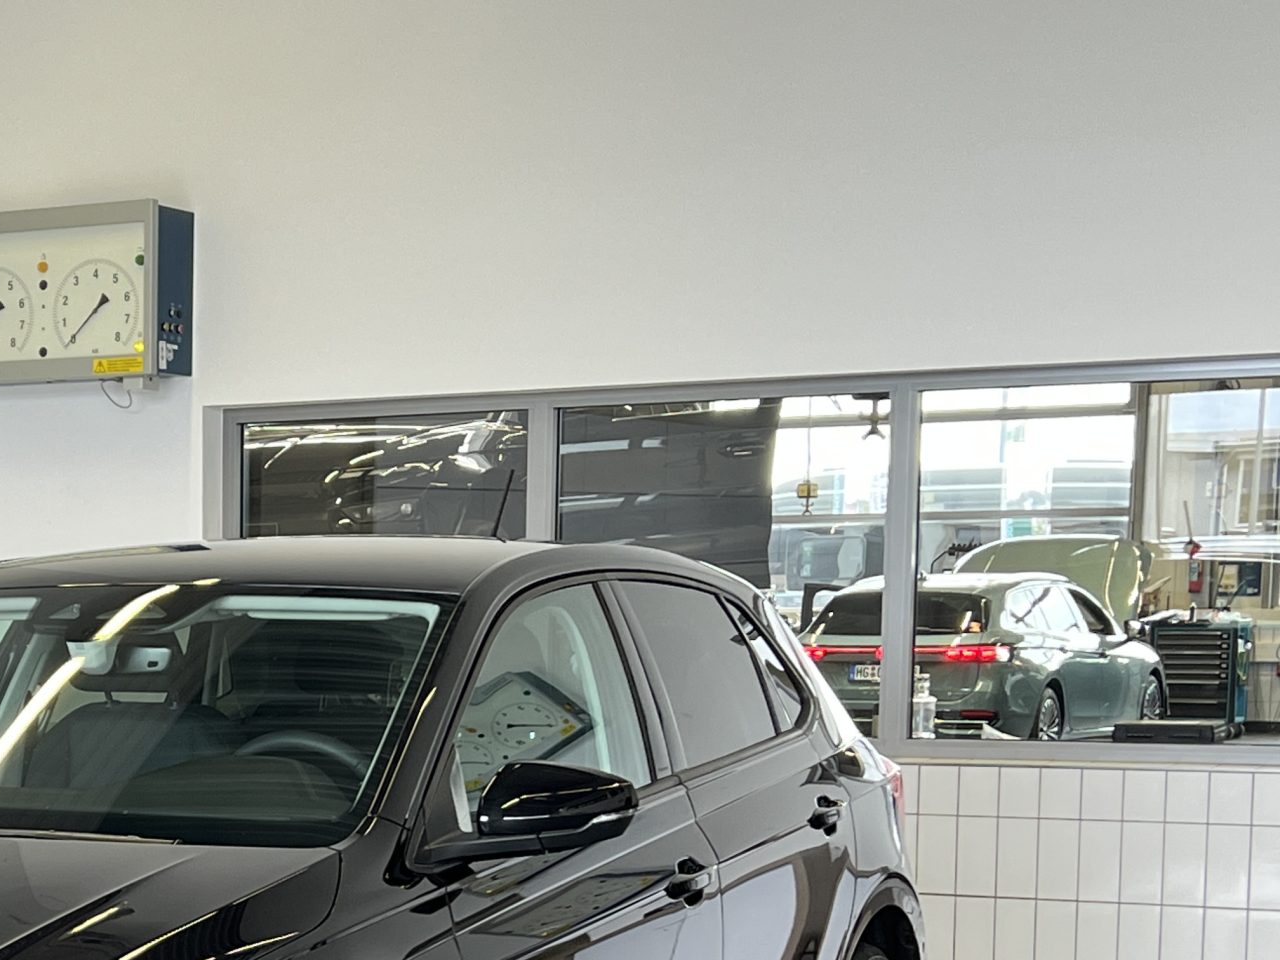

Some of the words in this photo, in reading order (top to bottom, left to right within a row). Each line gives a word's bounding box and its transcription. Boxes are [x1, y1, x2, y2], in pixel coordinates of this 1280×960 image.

[93, 268, 99, 279] 4
[112, 273, 119, 284] 5
[7, 280, 14, 291] 5
[73, 275, 79, 286] 3
[62, 296, 69, 306] 2
[124, 291, 130, 302] 6
[18, 298, 25, 309] 6
[124, 314, 131, 324] 7
[19, 320, 25, 330] 7
[114, 331, 121, 342] 8
[10, 337, 16, 348] 8
